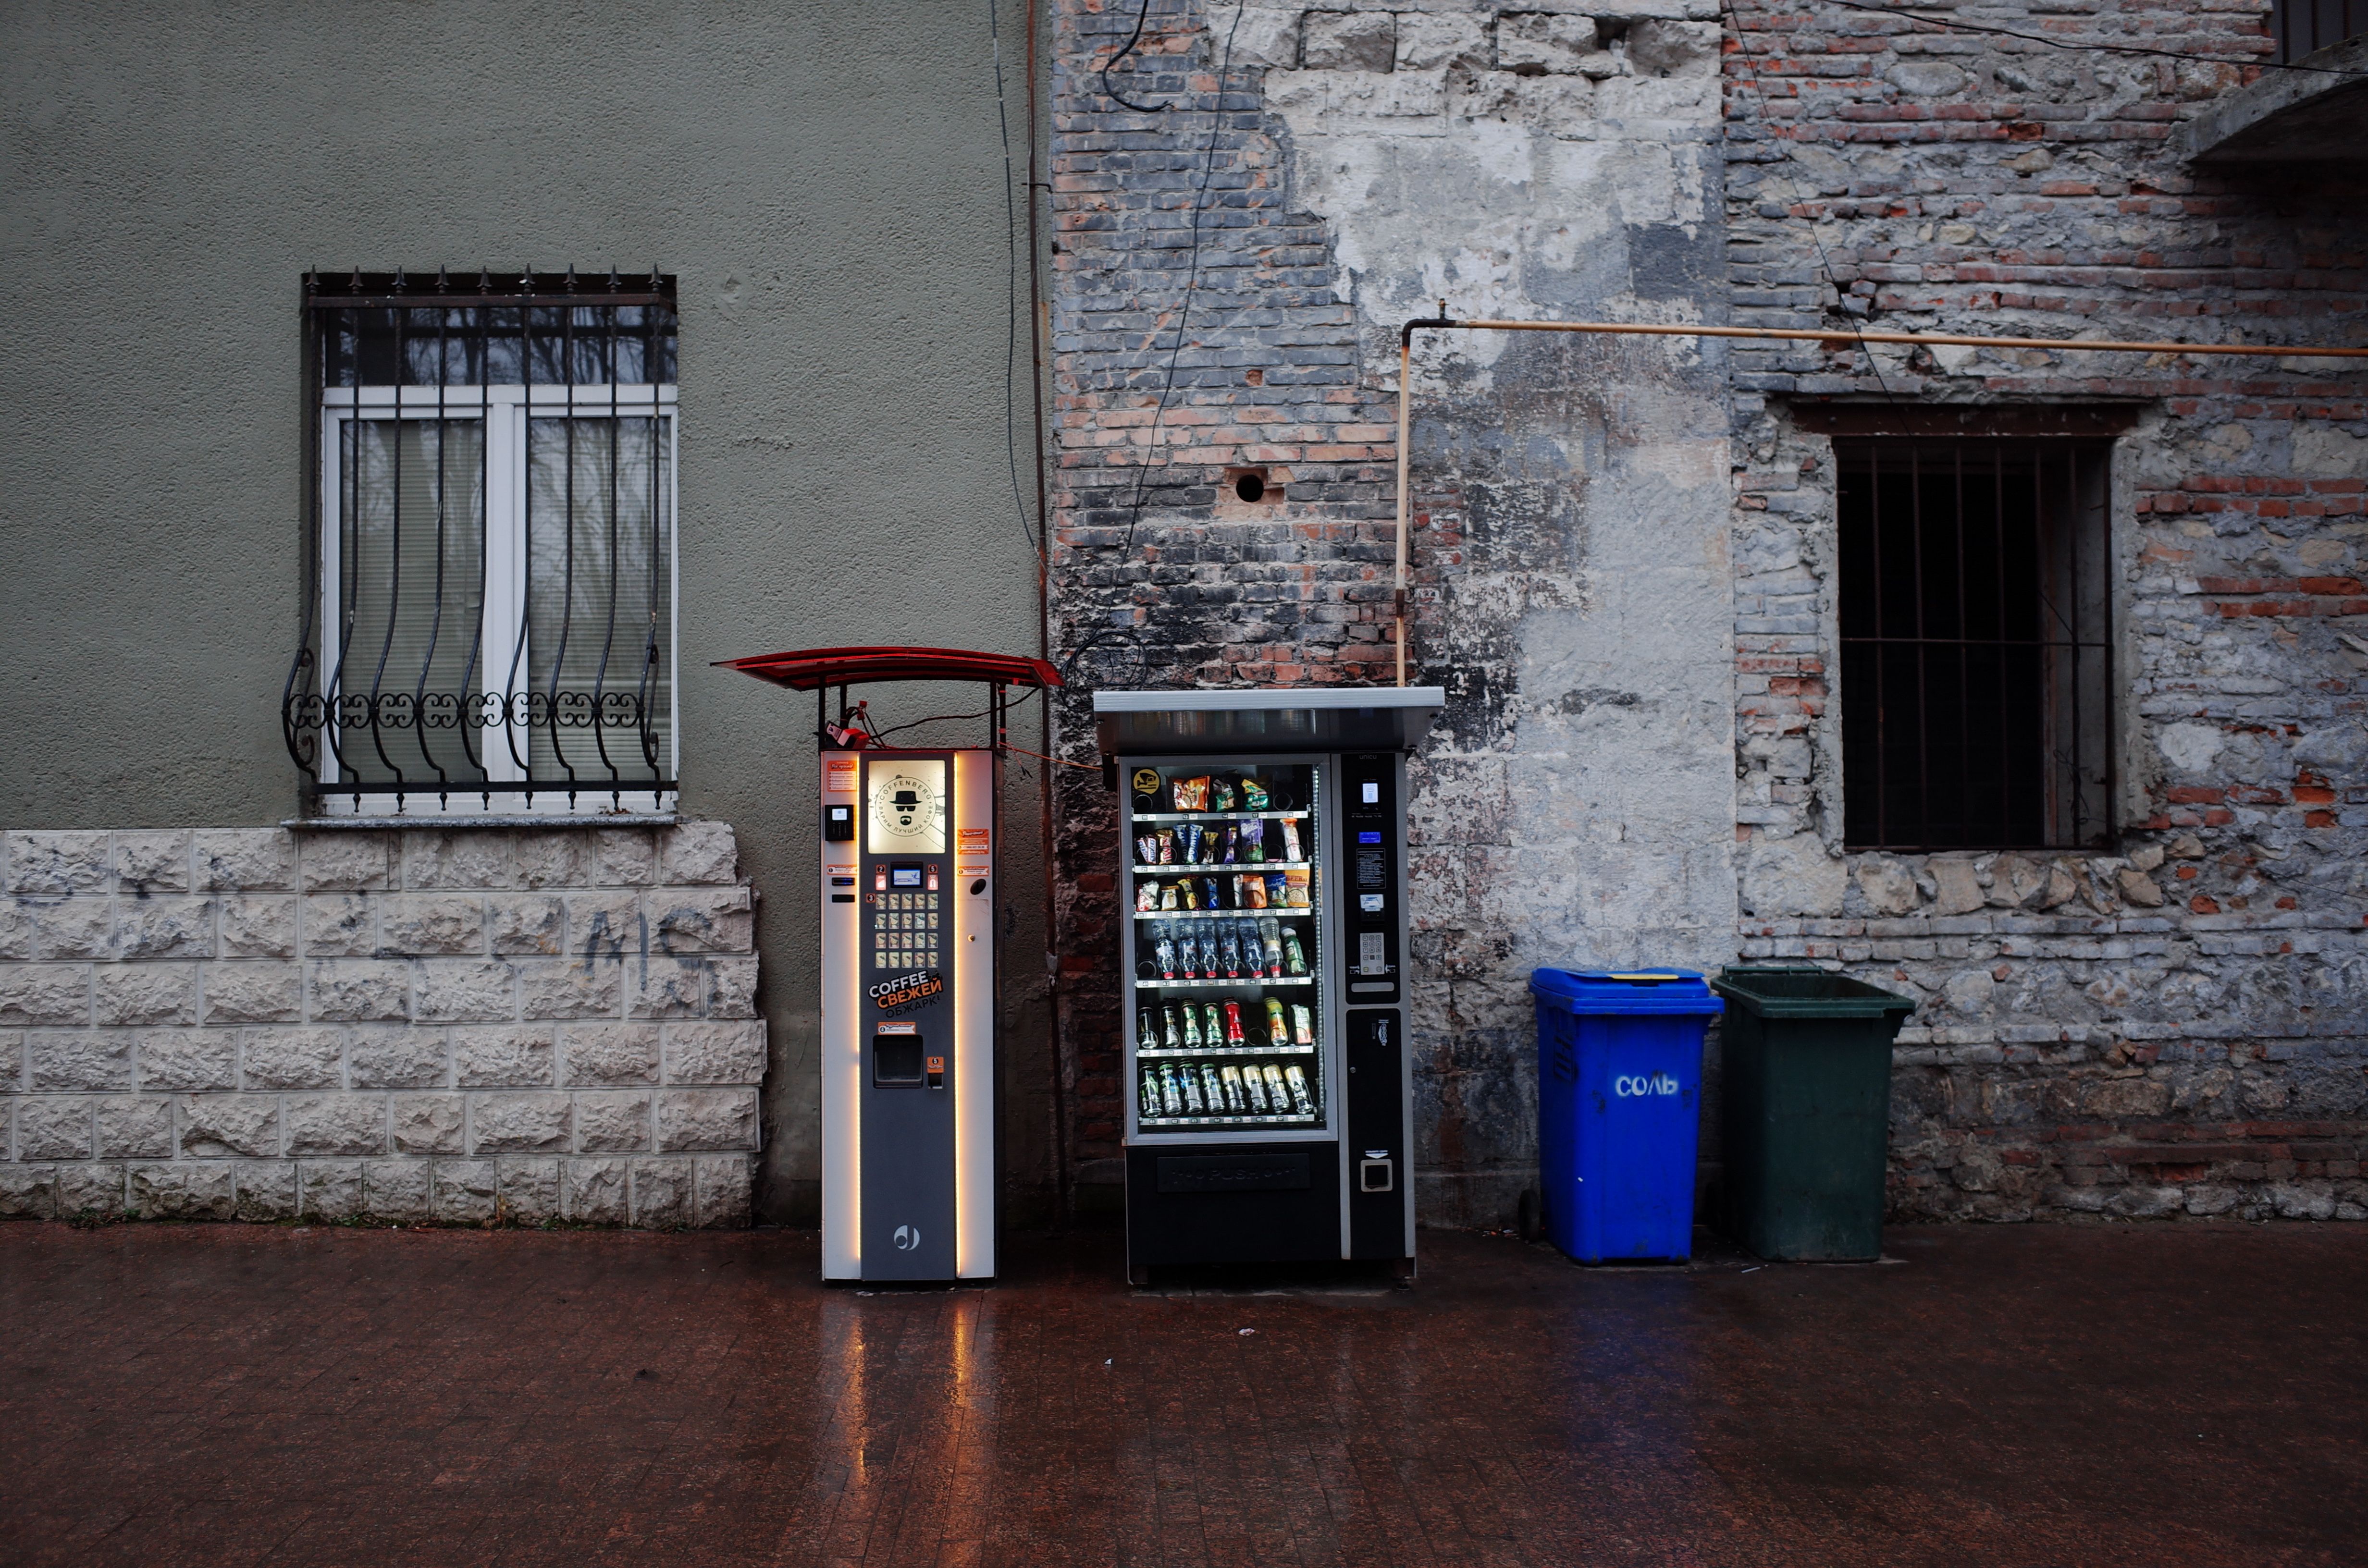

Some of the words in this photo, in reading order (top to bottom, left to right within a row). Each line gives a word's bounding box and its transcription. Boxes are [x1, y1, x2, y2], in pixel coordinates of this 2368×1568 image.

[879, 780, 932, 800] COFFENBERG
[879, 806, 892, 828] ВАРИМ
[893, 823, 923, 833] ЛУЧШИЙ
[923, 806, 933, 824] КОФЕ
[869, 970, 928, 998] COFFEE
[877, 977, 942, 1008] СВЕЖЕЙ
[1615, 1073, 1679, 1097] СОЛЬ
[1209, 1168, 1259, 1180] PUSH
